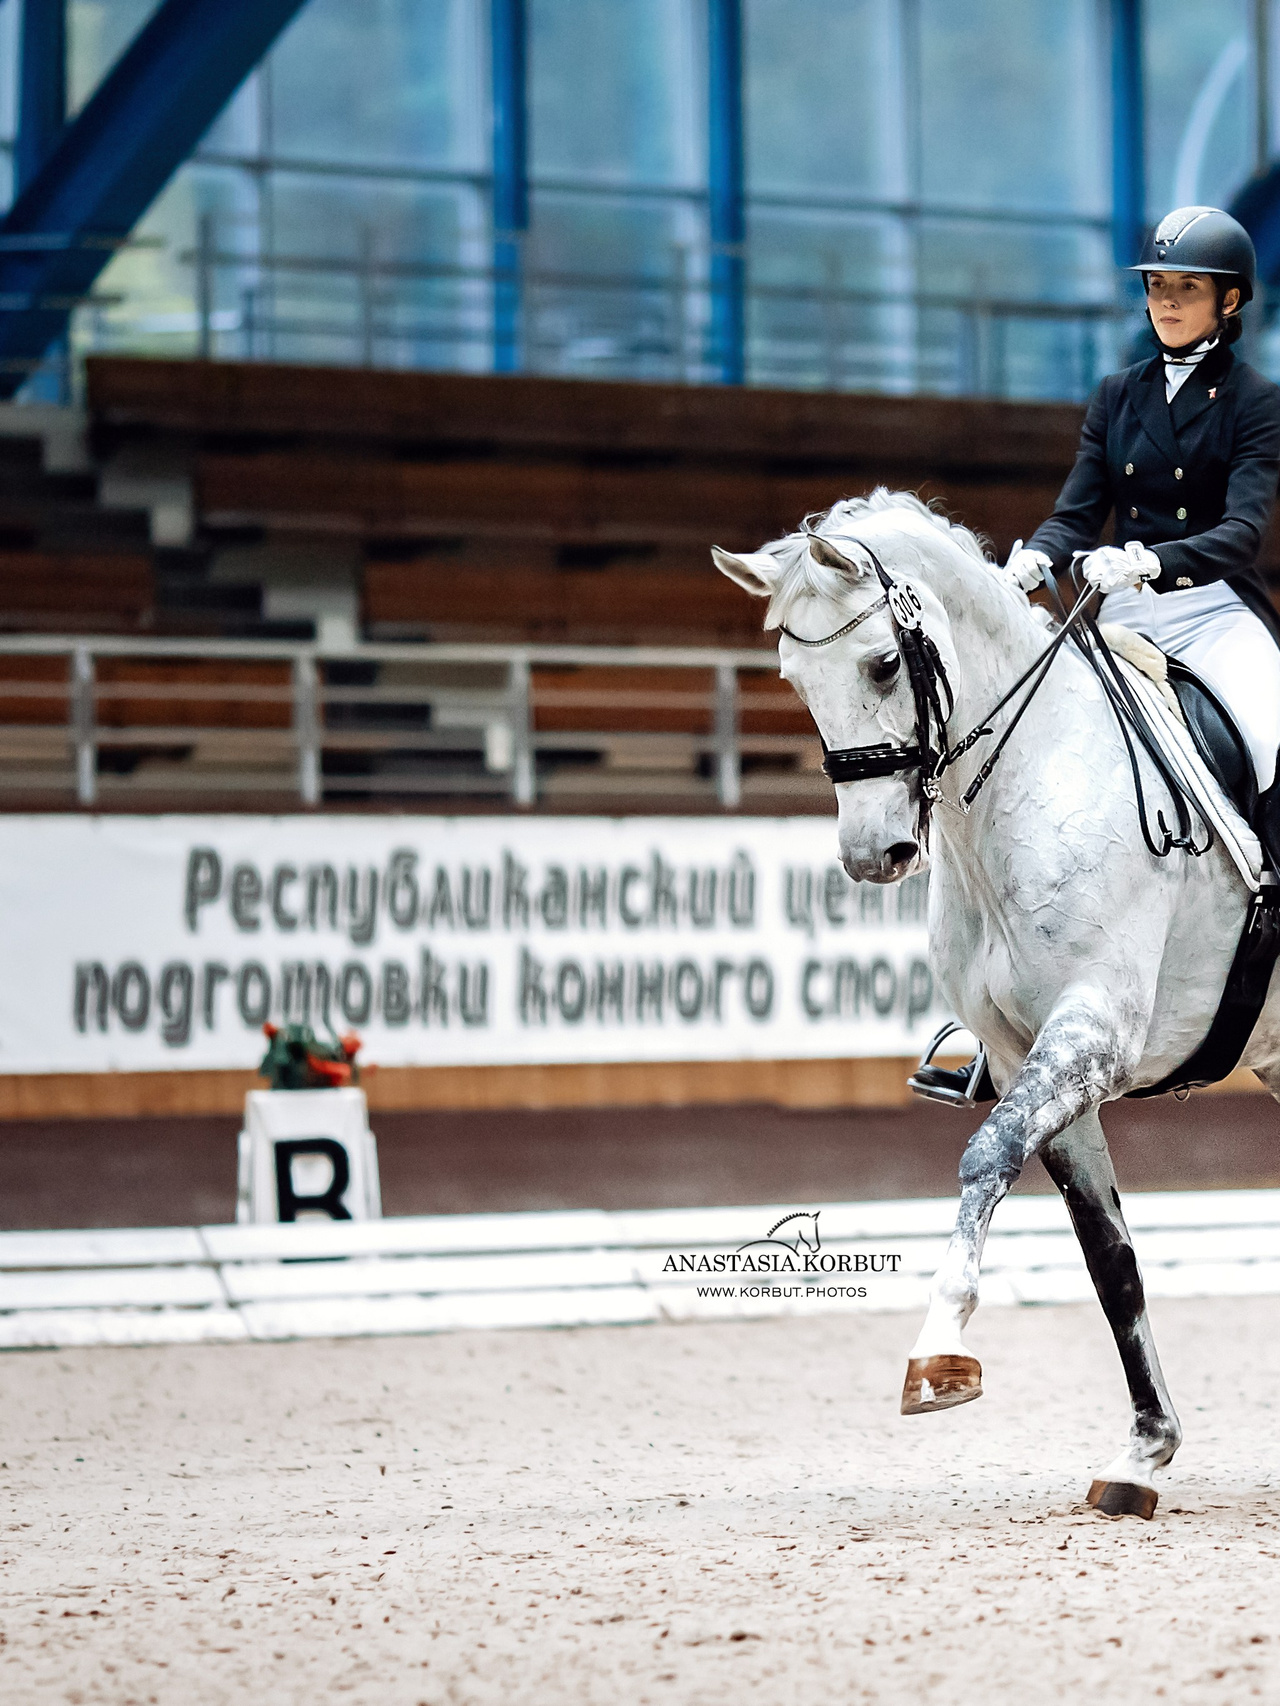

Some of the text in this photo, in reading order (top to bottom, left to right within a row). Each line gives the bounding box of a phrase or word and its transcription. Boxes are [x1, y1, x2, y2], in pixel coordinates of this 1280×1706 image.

[893, 584, 922, 624] 306
[184, 846, 755, 946] Республиканский
[74, 944, 488, 1047] подготовки
[517, 944, 774, 1027] конного
